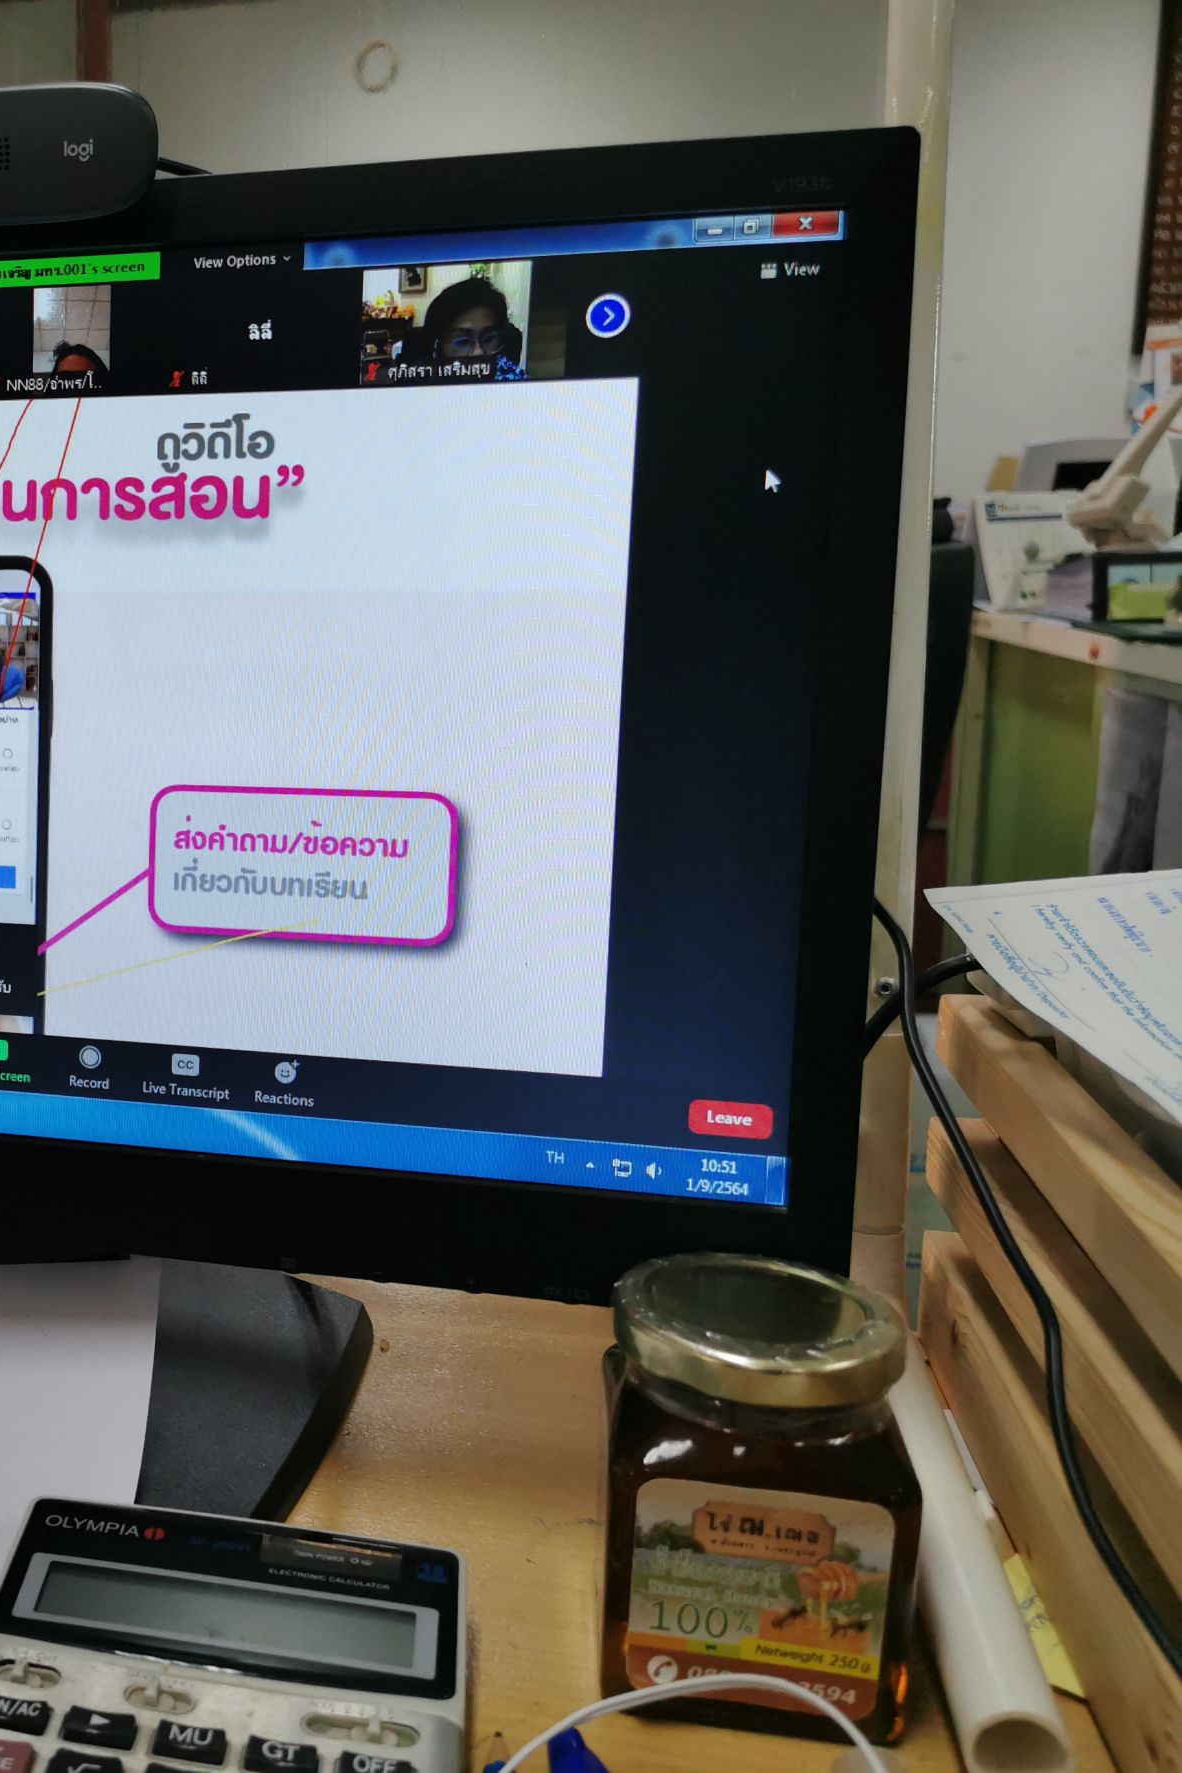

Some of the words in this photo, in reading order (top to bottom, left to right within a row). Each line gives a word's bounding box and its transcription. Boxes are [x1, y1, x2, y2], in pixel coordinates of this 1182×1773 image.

[63, 139, 94, 162] logi
[102, 261, 146, 273] screen
[194, 255, 223, 270] View
[226, 253, 277, 269] Options
[783, 261, 820, 277] View
[438, 360, 491, 379] เสริมสุข
[156, 412, 276, 474] ดูวิดีโอ
[173, 814, 409, 859] ส่งคำถาม/ข้อความ
[173, 857, 369, 901] เกี่ยวกับบทเรียน
[176, 1059, 195, 1071] CC
[68, 1075, 110, 1091] Record
[142, 1080, 166, 1096] Live
[168, 1082, 230, 1102] Transcript
[254, 1089, 315, 1107] Reactions
[706, 1109, 753, 1127] Leave
[546, 1150, 565, 1166] TH
[701, 1158, 737, 1175] 10:51
[686, 1177, 749, 1197] 1/9/2564
[44, 1513, 140, 1539] OLYMPIA
[268, 1567, 327, 1582] ELECTRONIC
[329, 1575, 391, 1591] CALCULATOR
[649, 1599, 756, 1640] 100%
[828, 1654, 859, 1672] 250
[169, 1724, 214, 1746] MU
[261, 1740, 301, 1762] GT
[352, 1753, 399, 1773] OFF
